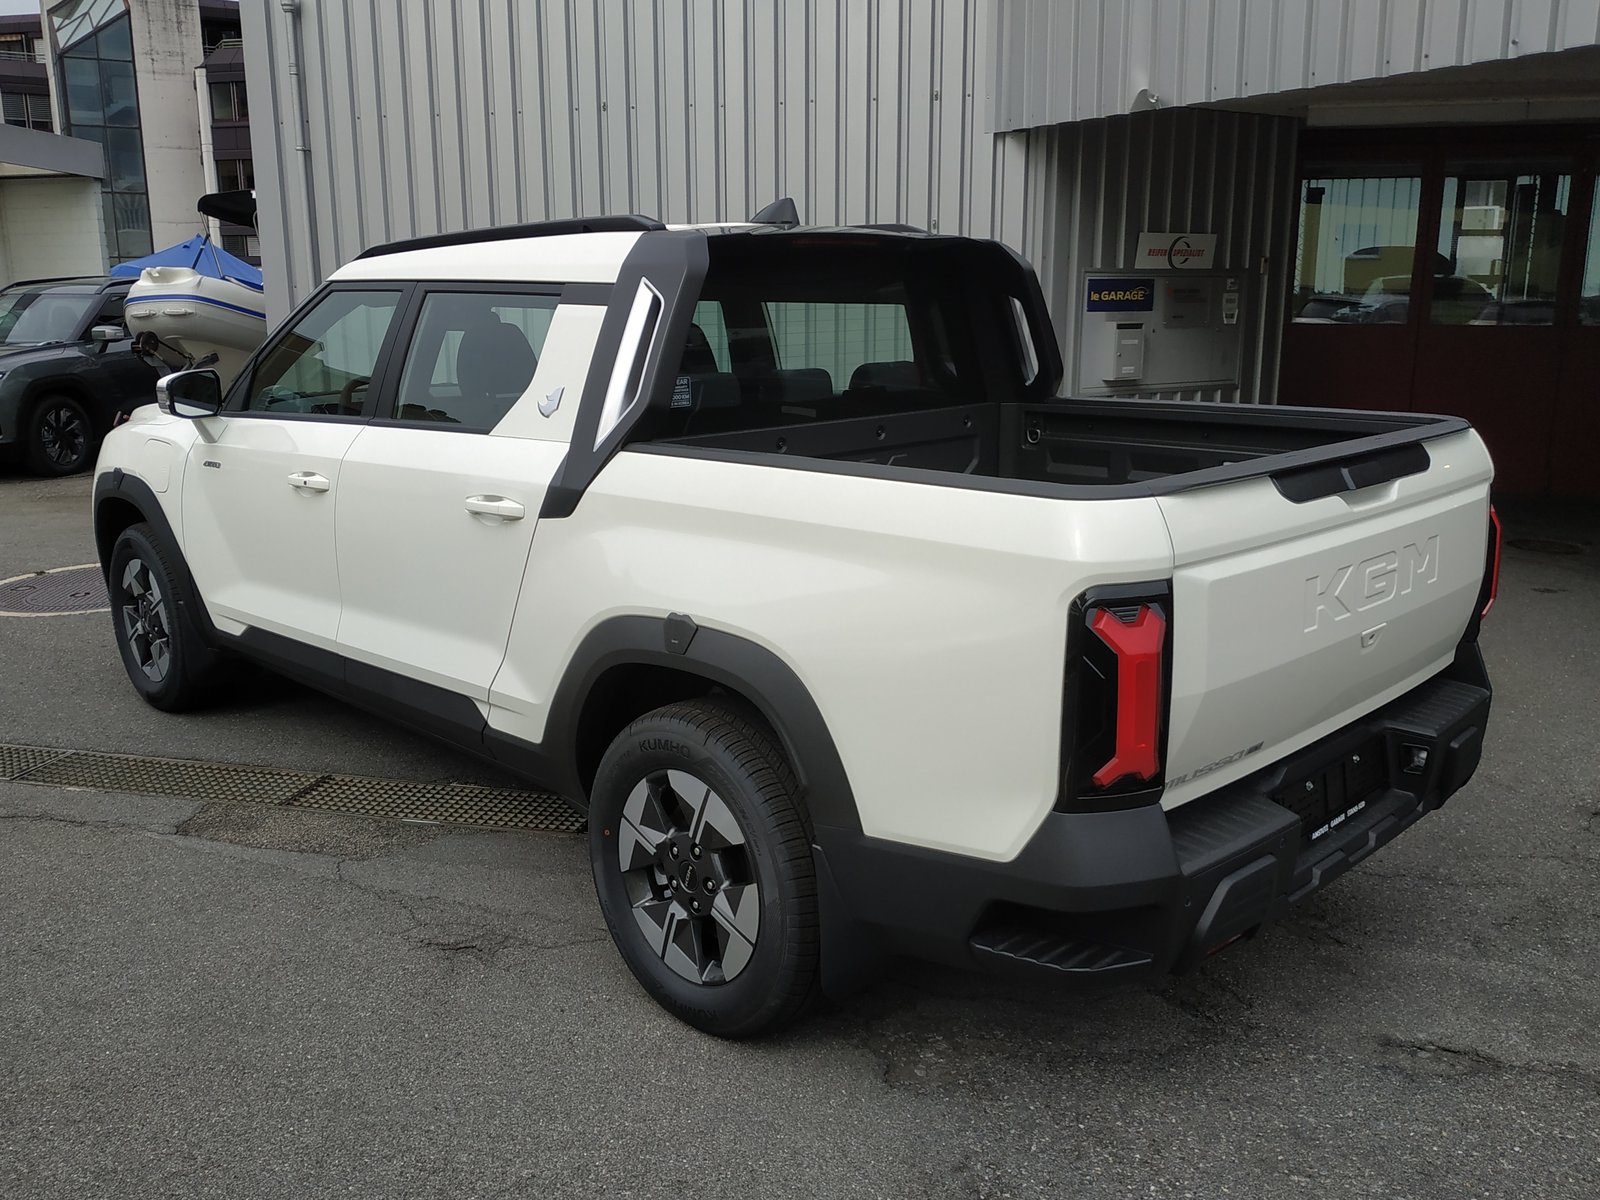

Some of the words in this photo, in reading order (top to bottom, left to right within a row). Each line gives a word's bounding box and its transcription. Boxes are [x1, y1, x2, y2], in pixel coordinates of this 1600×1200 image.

[1090, 291, 1099, 301] le
[1100, 291, 1145, 301] GARAGE
[1304, 534, 1440, 634] KGM
[639, 738, 690, 759] KUMHO
